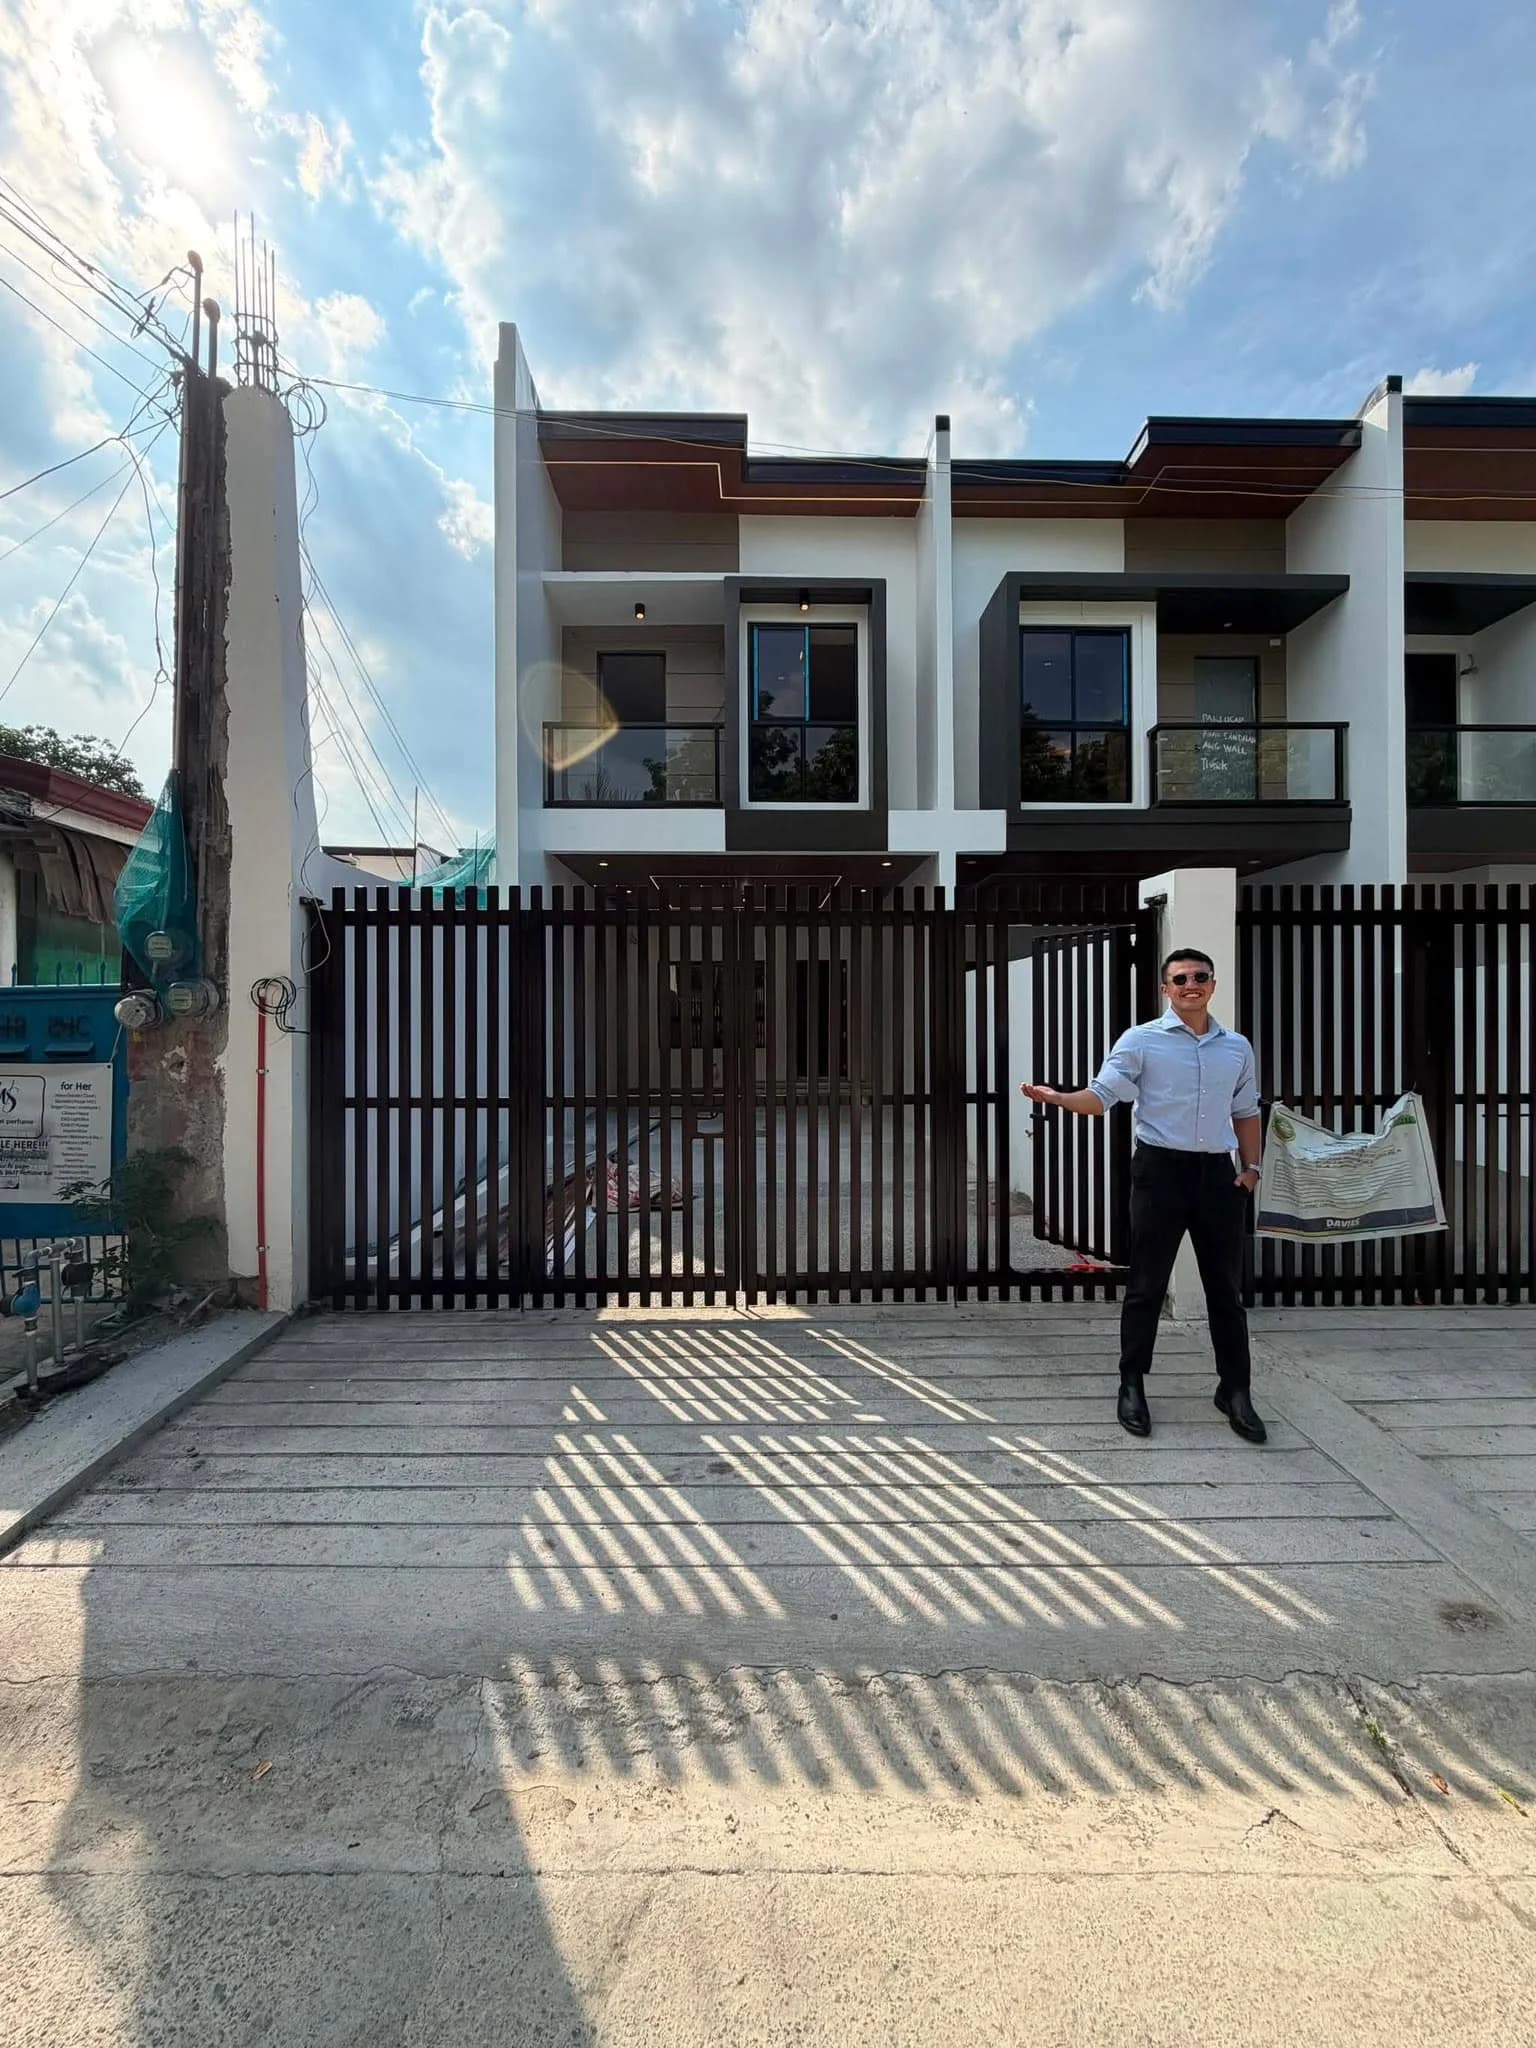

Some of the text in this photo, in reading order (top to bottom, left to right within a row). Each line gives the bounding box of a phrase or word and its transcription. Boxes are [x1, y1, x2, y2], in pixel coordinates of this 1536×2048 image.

[1223, 744, 1248, 755] WALL
[60, 1081, 92, 1090] for Her
